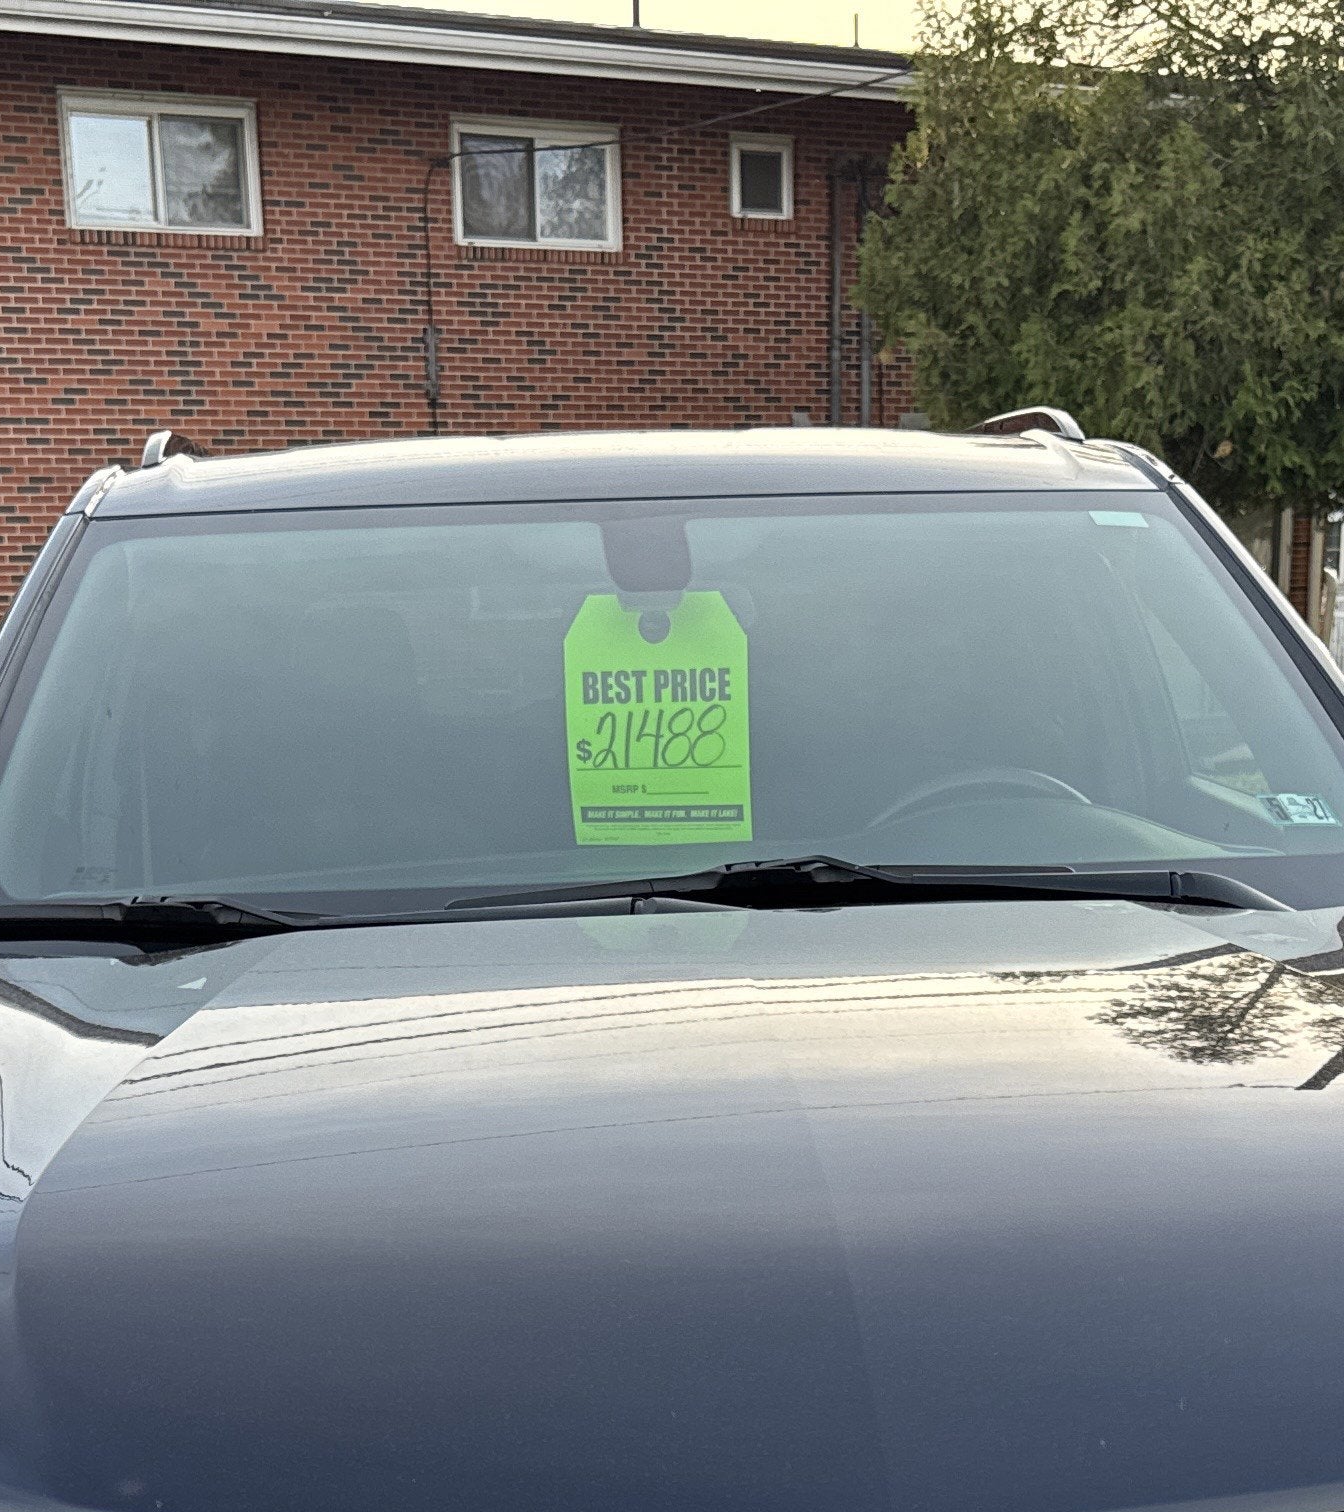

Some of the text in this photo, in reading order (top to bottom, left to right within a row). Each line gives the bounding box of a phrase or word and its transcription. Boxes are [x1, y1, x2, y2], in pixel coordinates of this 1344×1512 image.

[582, 667, 731, 705] BEST PRICE
[612, 784, 639, 794] MSRP
[588, 810, 606, 819] MAKE
[607, 810, 615, 819] IT
[644, 810, 663, 818] MAKE
[664, 810, 671, 818] IT
[690, 809, 709, 818] MAKE
[710, 809, 718, 818] IT
